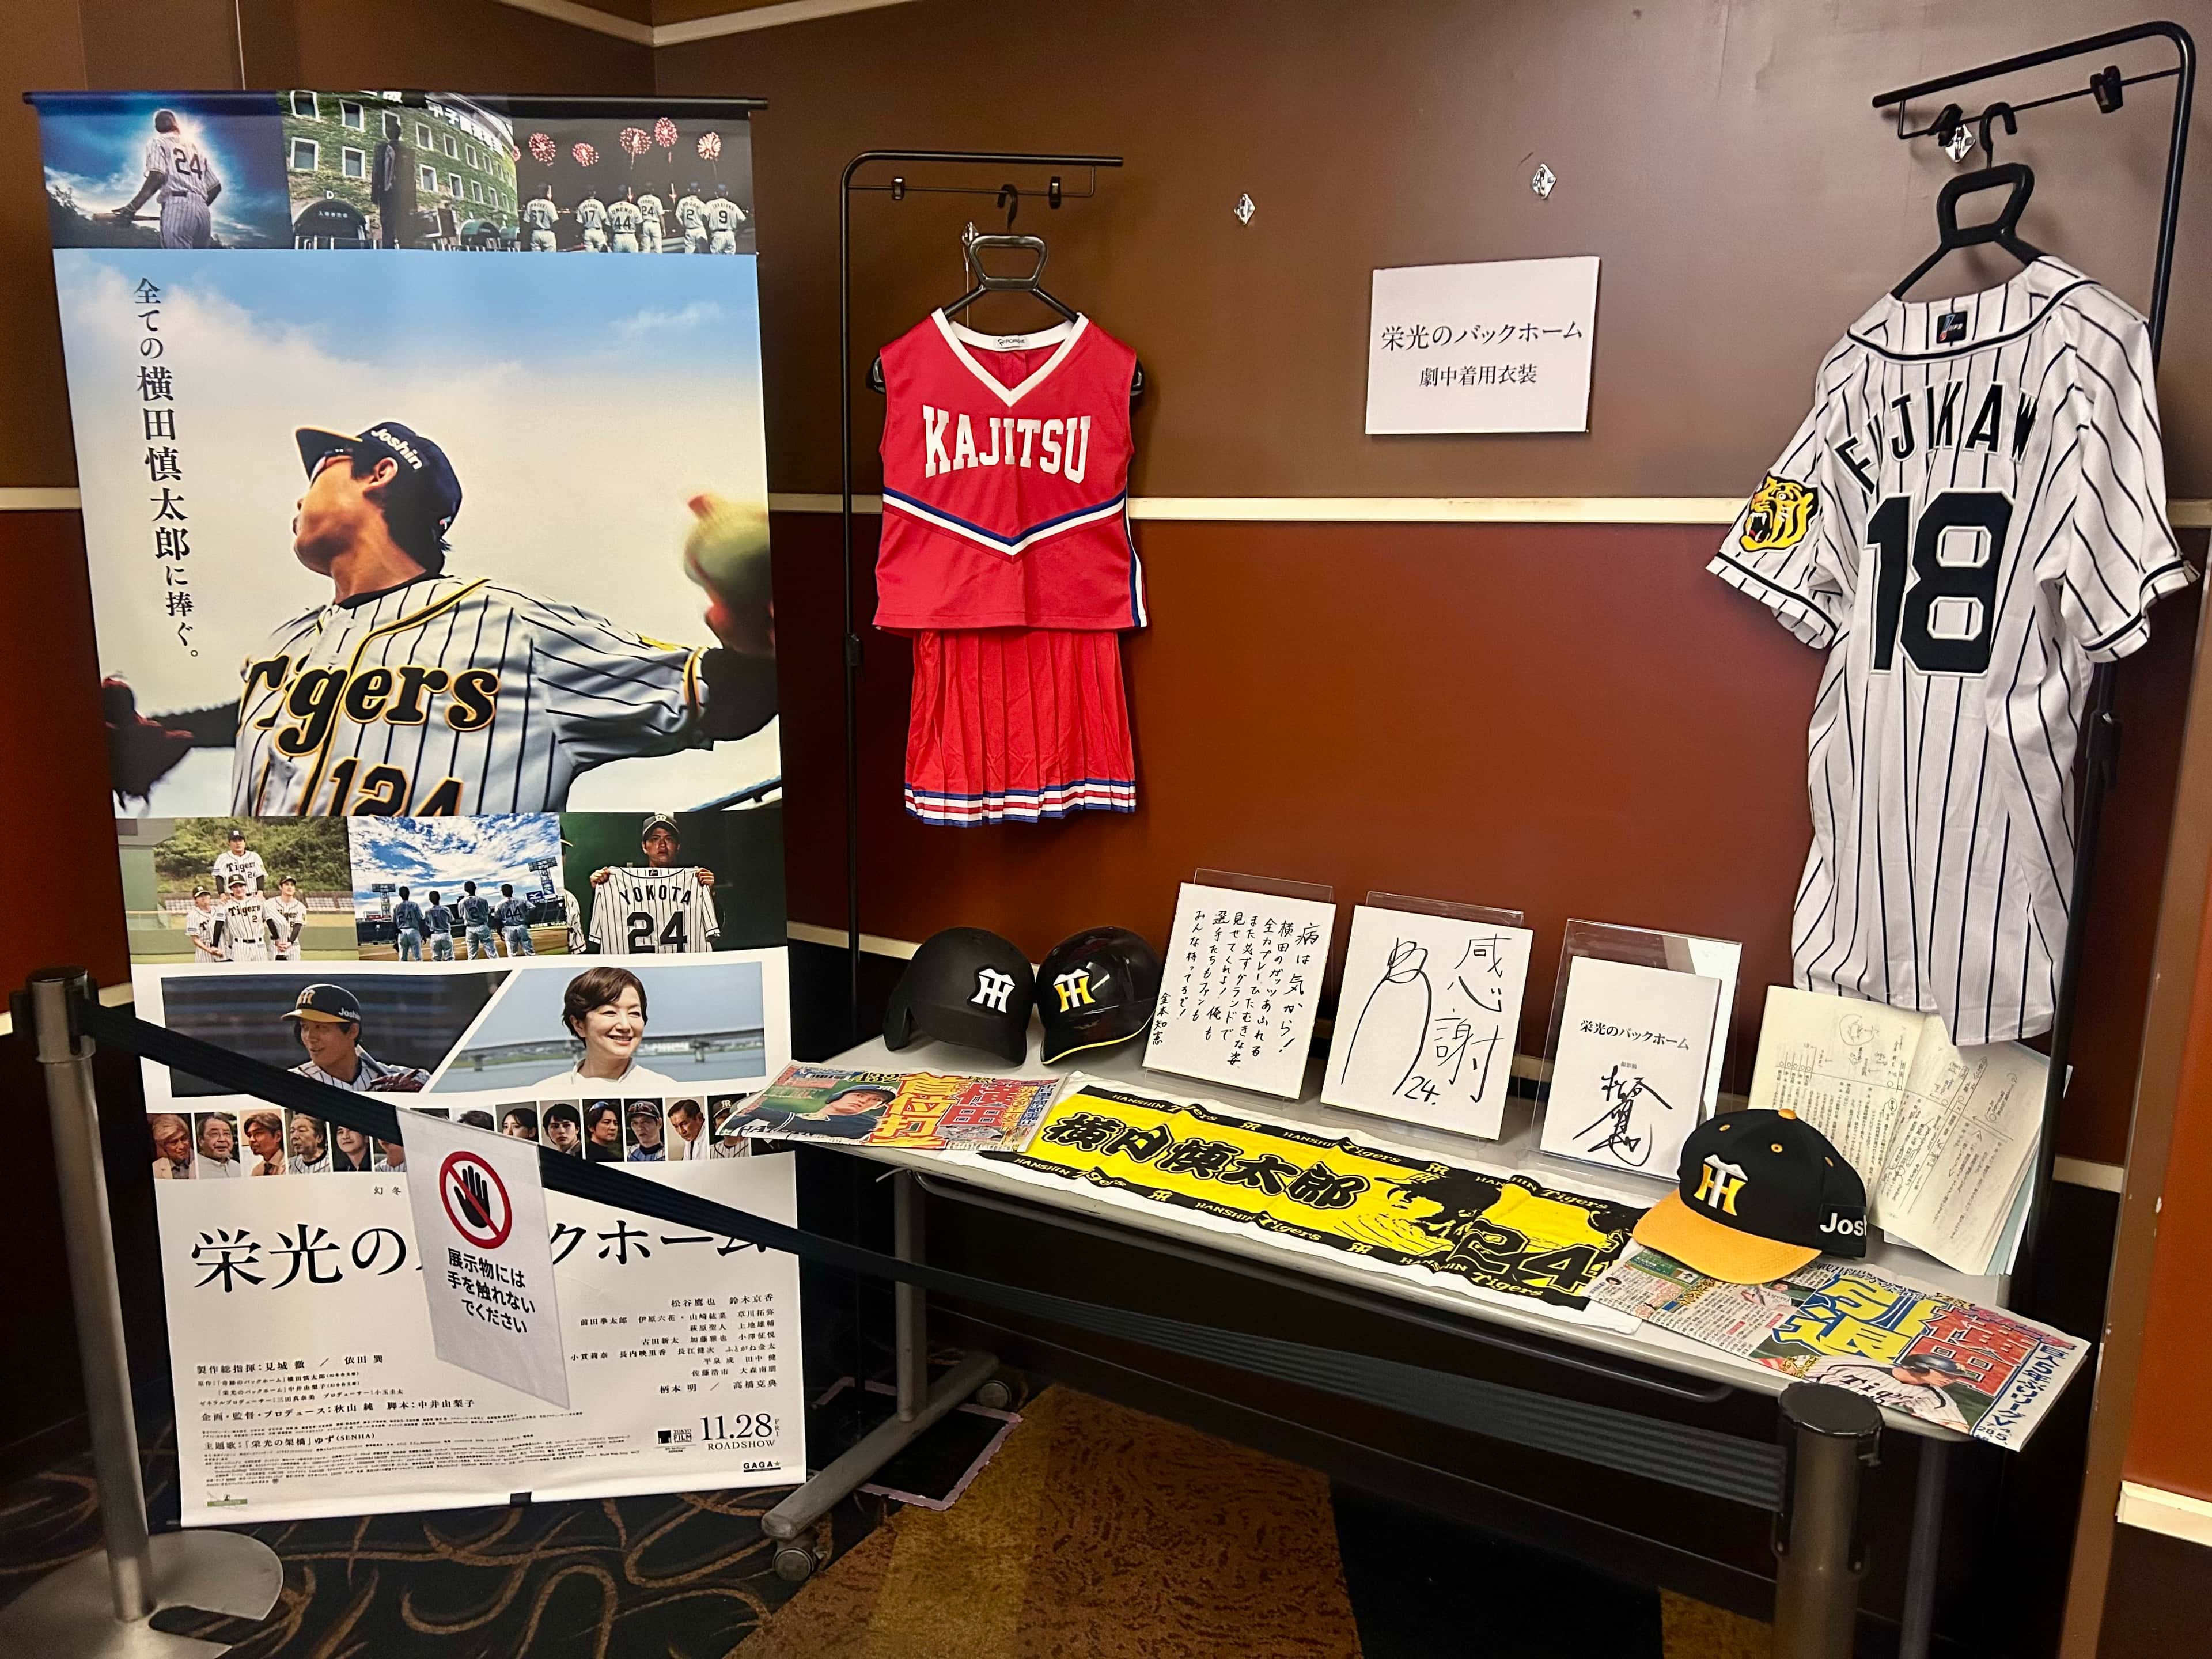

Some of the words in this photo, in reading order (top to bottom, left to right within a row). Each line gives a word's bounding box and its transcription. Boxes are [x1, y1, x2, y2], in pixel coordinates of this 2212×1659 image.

[173, 147, 203, 180] 24
[614, 215, 632, 230] 44
[641, 206, 654, 217] 24
[718, 210, 728, 224] 9
[1380, 320, 1583, 352] 栄光のバックホーム
[1419, 363, 1538, 388] 劇中着用衣装
[370, 426, 425, 472] Joshin
[923, 406, 1092, 485] KAJITSU
[134, 277, 199, 659] 全ての横田慎太郎に捧ぐ。
[1864, 488, 2018, 677] 18
[228, 904, 261, 918] Tigers
[619, 884, 692, 906] YOKOTA
[505, 907, 523, 920] 44
[626, 910, 688, 955] 24
[1580, 1018, 1690, 1051] 栄光のバックホーム
[939, 1082, 1020, 1127] 横田
[1013, 1157, 1071, 1176] HANSHIN
[1041, 1110, 1371, 1210] 横田慎太郎
[1343, 1140, 1402, 1164] Tigers
[1540, 1188, 1609, 1210] Tigers
[1194, 1200, 1256, 1222] HANSHIN
[1255, 1212, 1322, 1241] Tigers
[447, 1247, 525, 1289] 展示物には
[1446, 1217, 1601, 1294] 24
[446, 1271, 536, 1315] 手を触れない
[1471, 1271, 1544, 1297] Tigers
[461, 1297, 528, 1334] でください
[671, 1297, 716, 1308] 松谷鷹也
[729, 1293, 774, 1305] 鈴木京香
[1774, 1273, 1952, 1366] 引退
[1902, 1304, 2041, 1399] 横田
[700, 1412, 773, 1441] 11.28
[707, 1440, 775, 1451] ROADSHOW
[743, 1460, 774, 1469] GAGA
